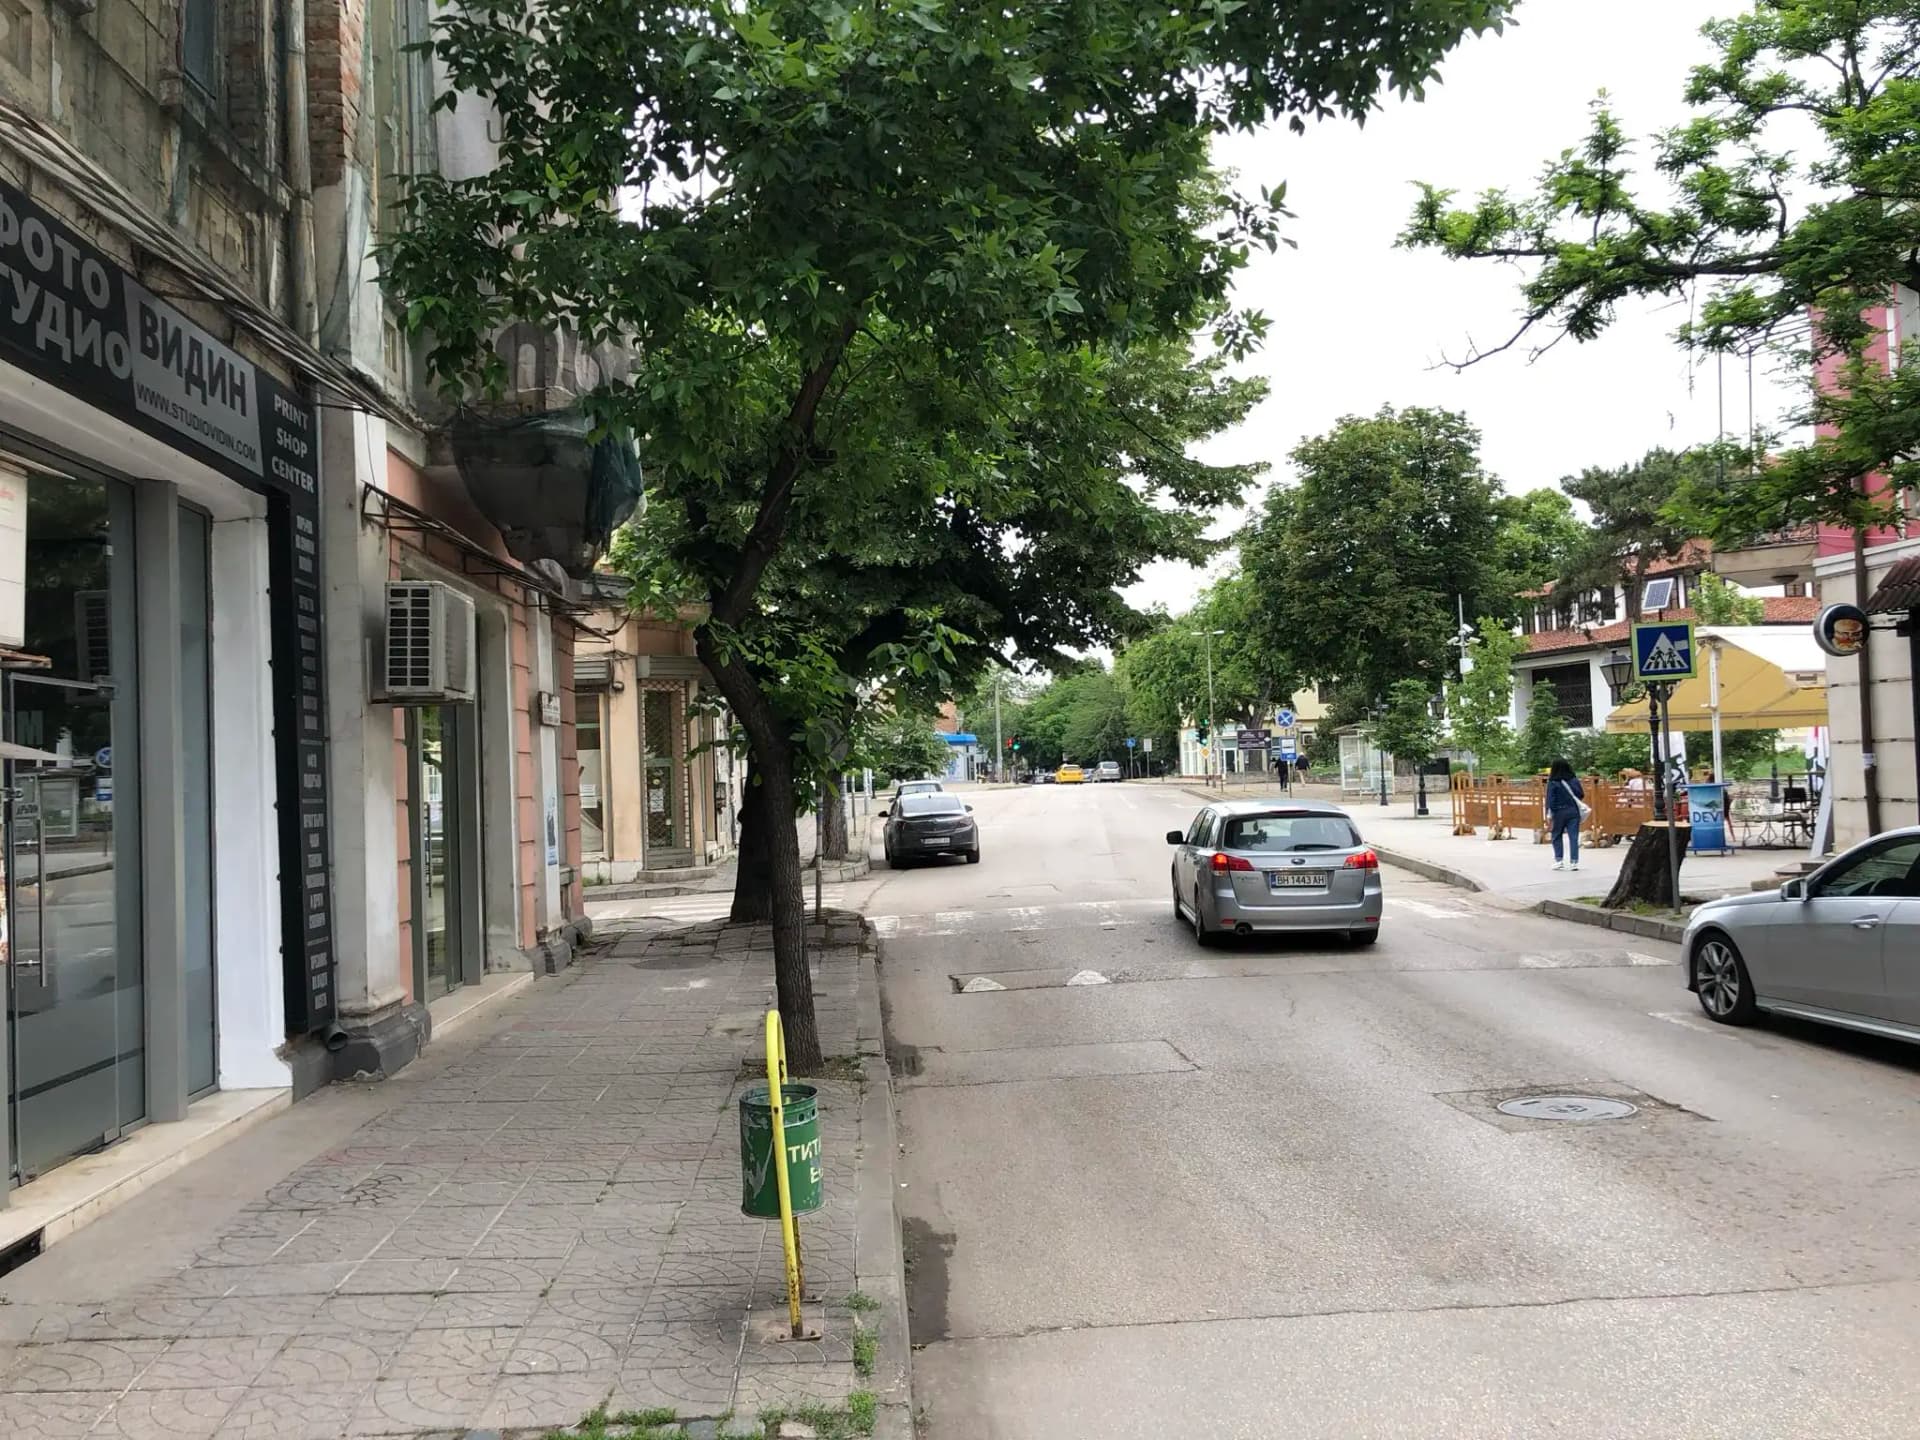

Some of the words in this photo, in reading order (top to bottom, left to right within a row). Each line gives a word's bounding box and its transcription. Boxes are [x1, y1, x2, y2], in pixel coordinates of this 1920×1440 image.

[138, 300, 248, 417] ВИДИН
[137, 381, 258, 464] WWW.STUDIOVIDIN.COM
[273, 393, 309, 431] PRINT
[276, 427, 309, 459] SHOP
[271, 455, 314, 494] CENTER
